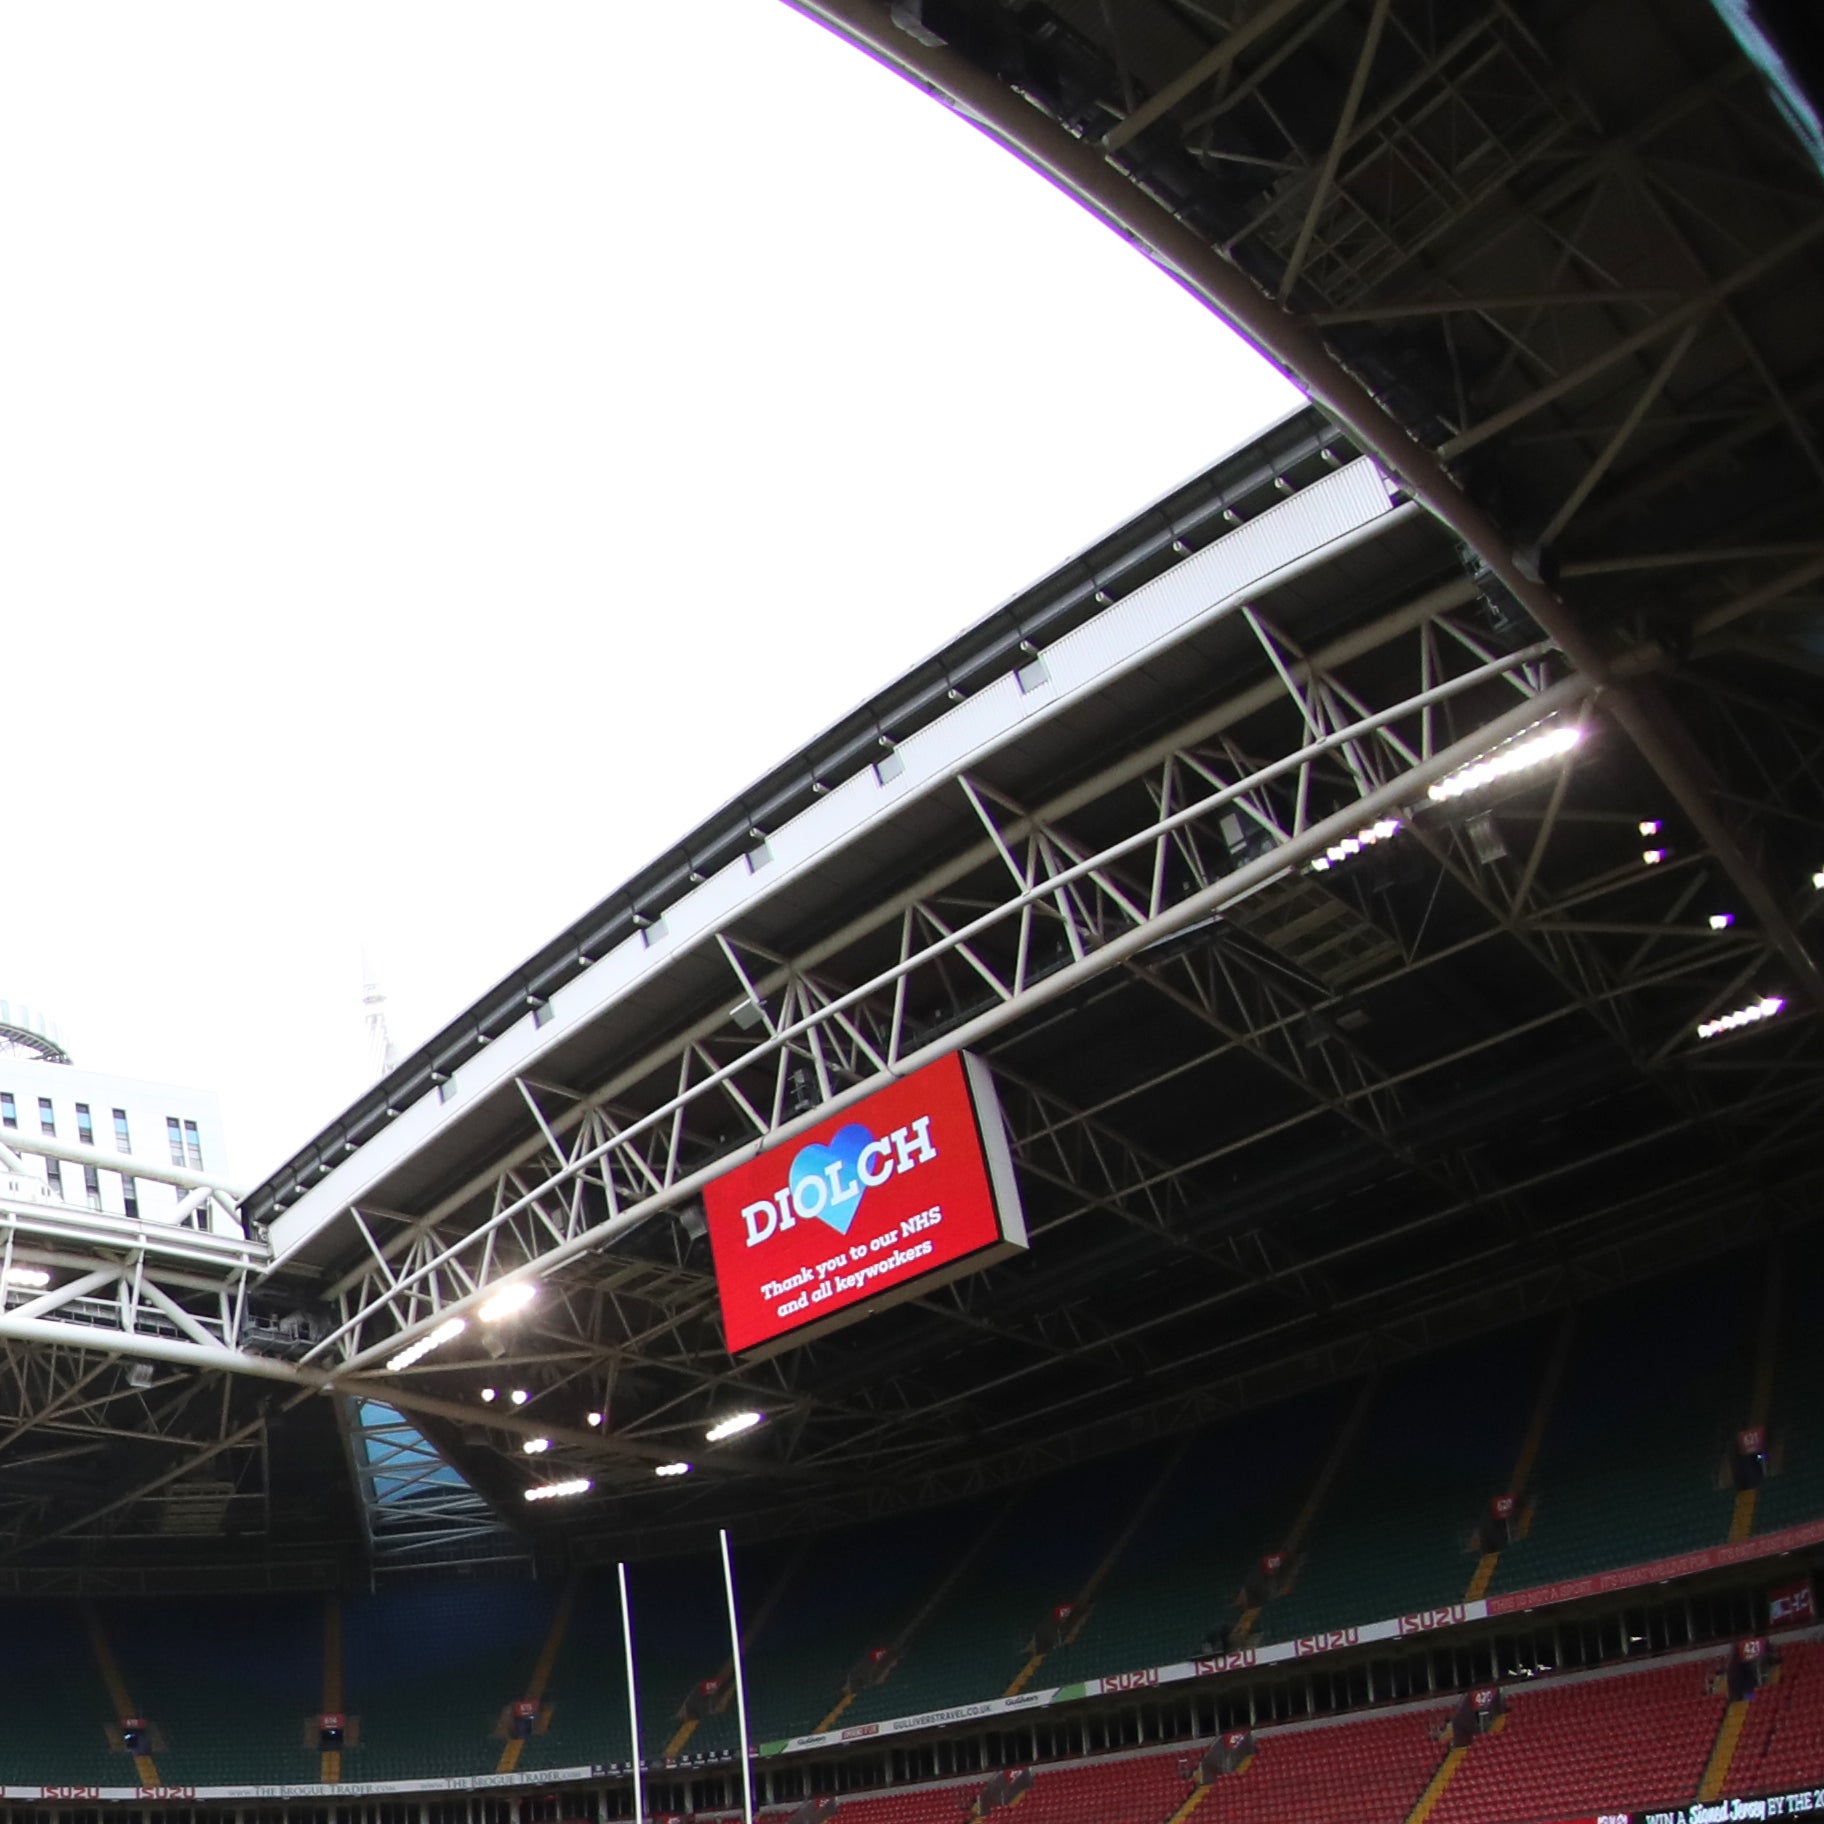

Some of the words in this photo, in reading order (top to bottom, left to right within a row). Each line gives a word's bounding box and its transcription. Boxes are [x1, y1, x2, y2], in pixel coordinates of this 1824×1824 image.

[741, 1116, 938, 1248] DIOLCH
[760, 1267, 815, 1301] Thank
[816, 1251, 848, 1281] you
[850, 1243, 867, 1261] to
[870, 1229, 898, 1252] our
[901, 1206, 943, 1239] NHS
[777, 1295, 809, 1318] and
[811, 1285, 833, 1305] all
[834, 1240, 933, 1290] keyworkers
[1398, 1604, 1466, 1635] ISUZU
[1294, 1627, 1359, 1657] ISUZU
[1744, 1641, 1761, 1653] 421
[1195, 1650, 1256, 1676] ISUZU
[1100, 1668, 1159, 1693] ISUZU
[41, 1786, 99, 1799] ISUZU
[254, 1784, 277, 1797] THE
[327, 1784, 373, 1796] TRADER
[445, 1777, 469, 1790] THE
[519, 1770, 561, 1785] TRADER
[137, 1787, 195, 1800] ISUZU
[1729, 1799, 1766, 1821] Jersey
[1768, 1797, 1785, 1815] BY
[1787, 1792, 1813, 1816] THE
